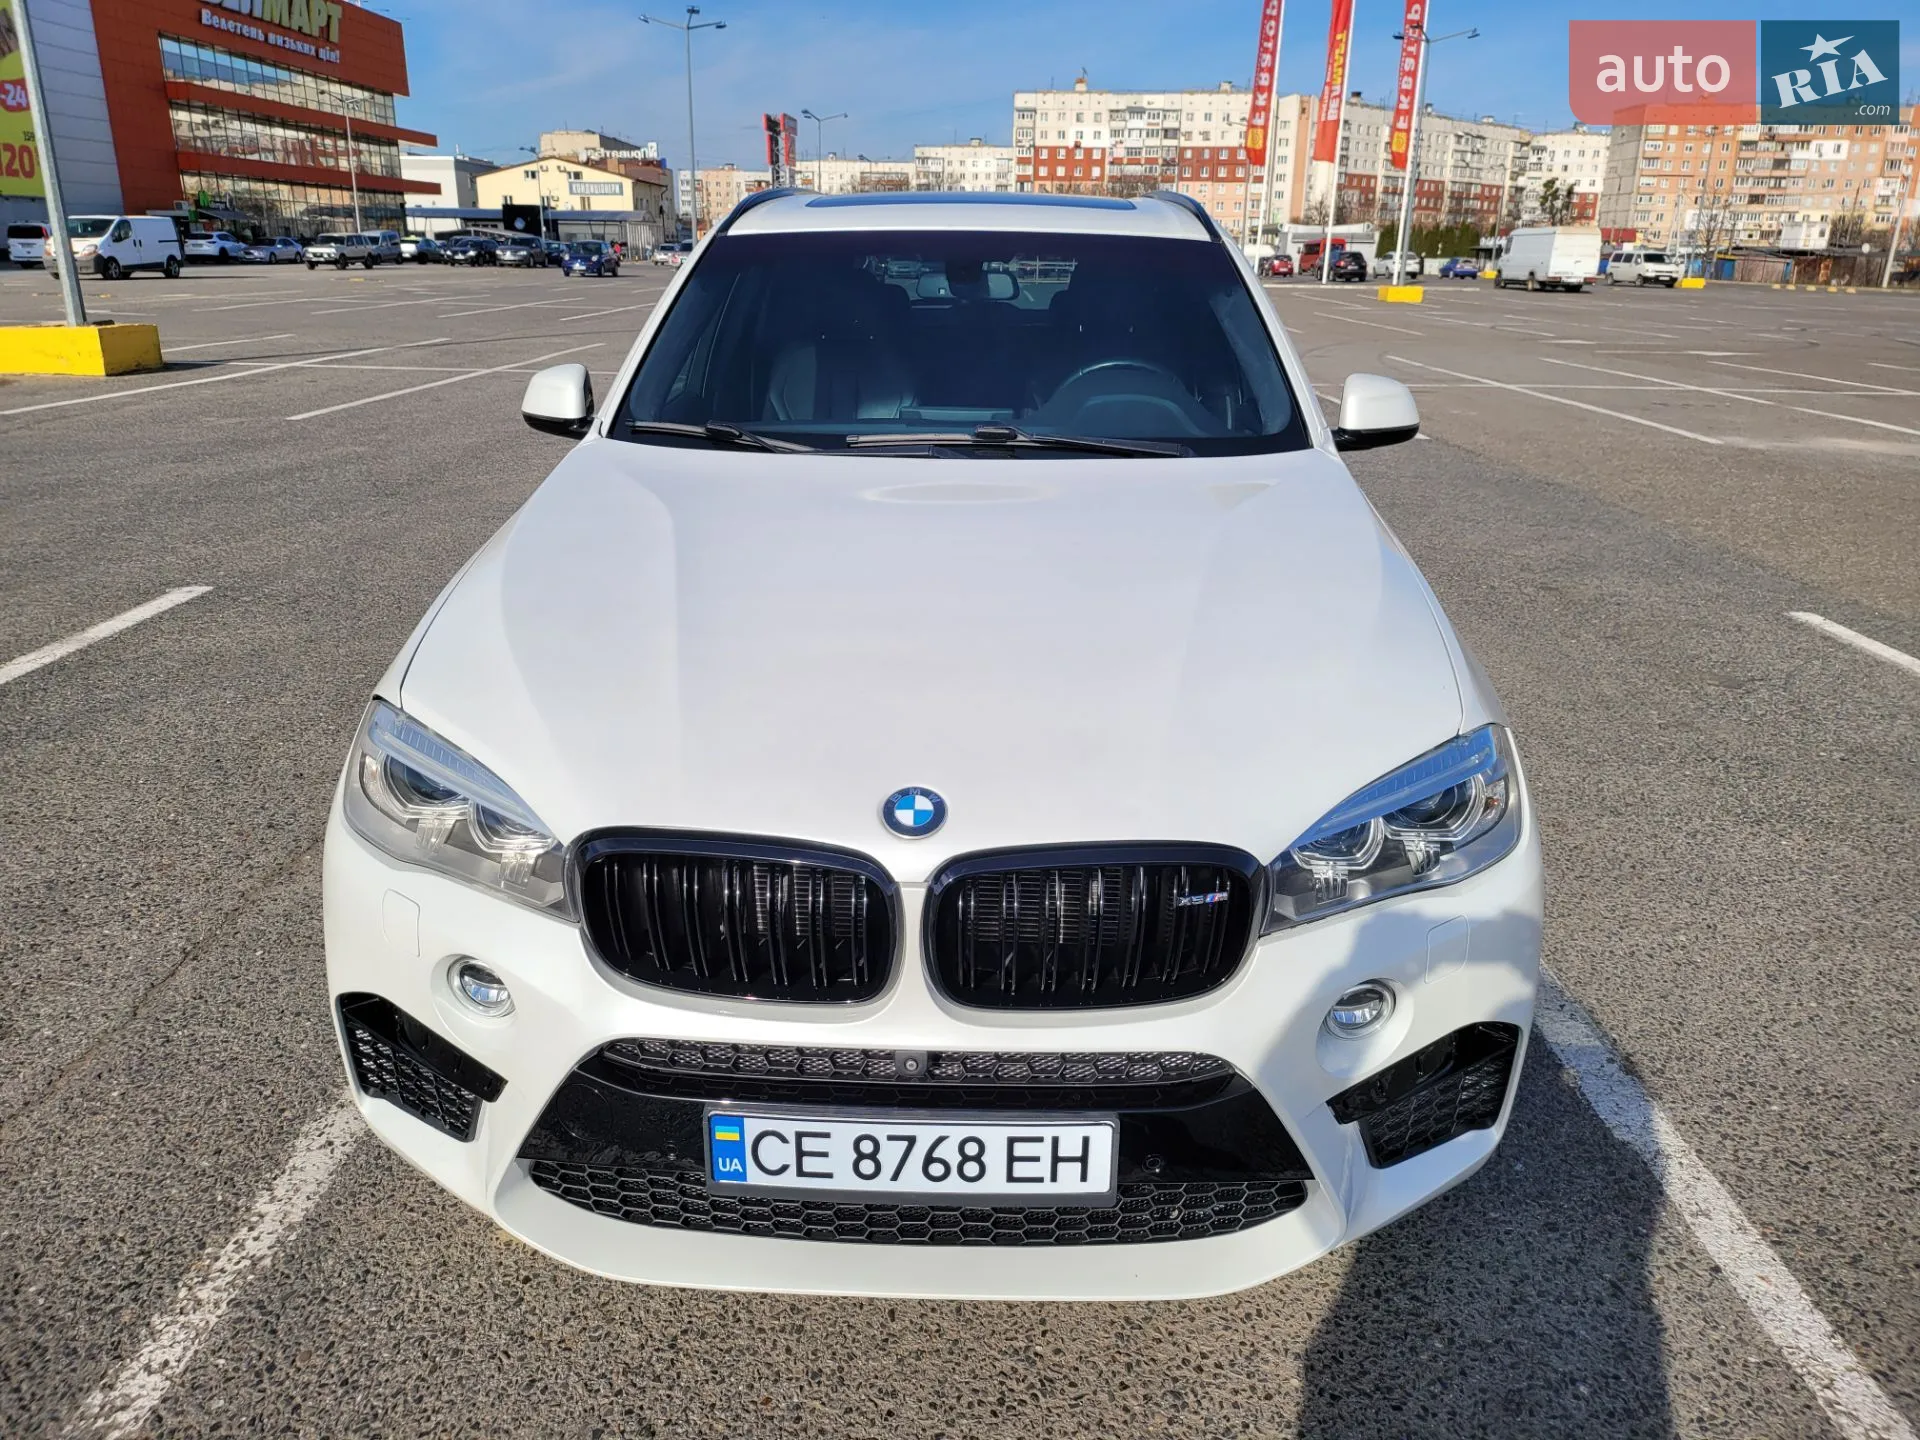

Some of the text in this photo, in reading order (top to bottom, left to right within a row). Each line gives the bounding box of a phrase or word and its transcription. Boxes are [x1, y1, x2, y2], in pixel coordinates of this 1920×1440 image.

[201, 8, 265, 41] Велетень
[267, 32, 316, 56] низьких
[890, 788, 941, 803] BMW
[718, 1157, 743, 1172] UA
[751, 1129, 1090, 1183] CE 8768 EH
